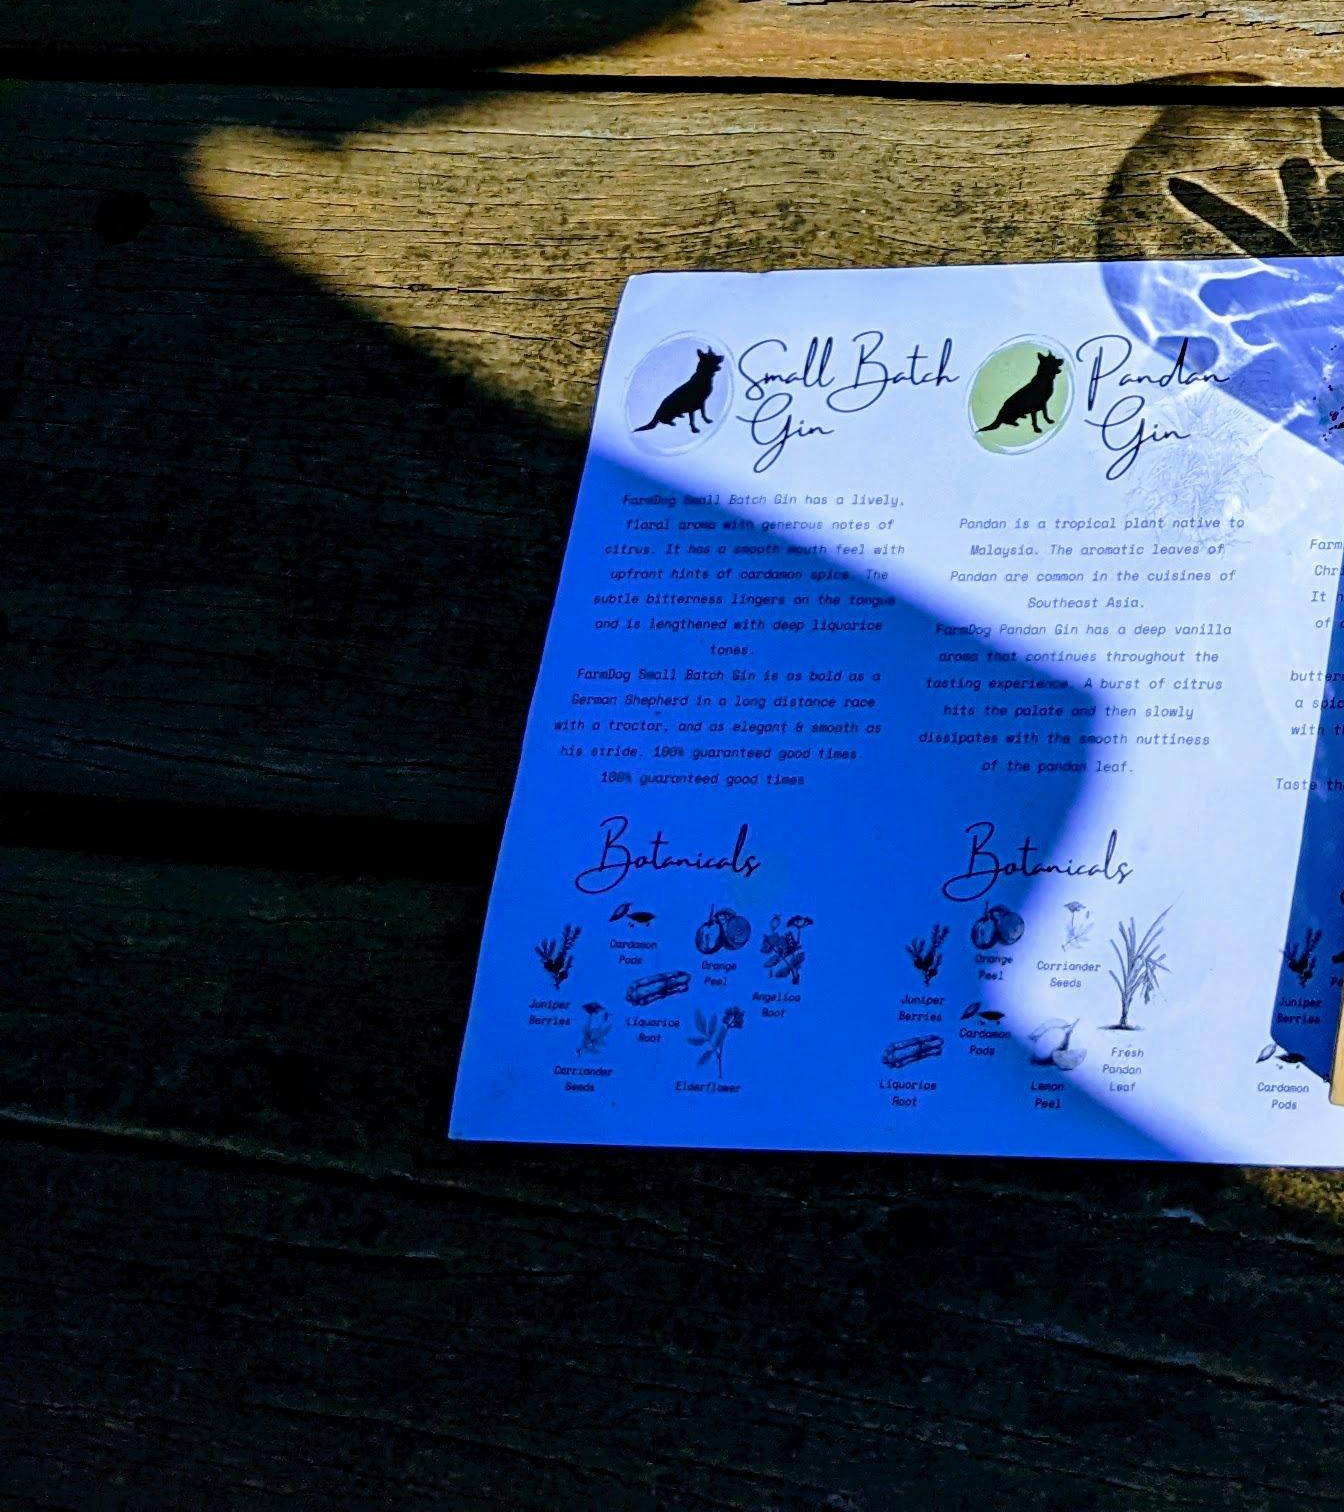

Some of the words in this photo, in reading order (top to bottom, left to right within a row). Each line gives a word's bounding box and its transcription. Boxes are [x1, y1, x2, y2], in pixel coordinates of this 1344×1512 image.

[737, 336, 836, 402] Small
[826, 330, 961, 414] Batch
[1075, 334, 1231, 411] Pandan
[735, 392, 835, 474] Gin
[1083, 394, 1192, 481] Gin
[622, 494, 677, 509] FarmDog
[683, 494, 721, 507] Small
[728, 493, 767, 507] Batch
[773, 492, 798, 506] Gin
[804, 493, 828, 506] has
[835, 496, 845, 506] a
[851, 493, 905, 509] lively,
[625, 518, 671, 532] floral
[761, 520, 824, 534] generous
[831, 518, 871, 532] notes
[877, 518, 896, 531] of
[959, 517, 1007, 530] Pandan
[1014, 516, 1031, 530] is
[1037, 520, 1047, 530] a
[1053, 516, 1117, 534] tropical
[1123, 516, 1165, 533] plant
[1171, 516, 1221, 530] native
[1228, 517, 1245, 530] to
[970, 543, 1041, 560] Malaysia.
[1049, 543, 1074, 556] The
[1080, 543, 1145, 556] aromatic
[1151, 542, 1200, 556] leaves
[1206, 542, 1225, 556] of
[949, 569, 998, 583] Pandan
[1004, 572, 1030, 583] are
[1035, 571, 1086, 583] common
[1091, 569, 1109, 582] in
[1115, 569, 1141, 582] the
[1146, 569, 1212, 582] cuisines
[1218, 568, 1237, 582] of
[1027, 596, 1099, 610] Southeast
[1105, 596, 1146, 610] Asia.
[935, 623, 993, 639] FarmDog
[999, 623, 1048, 636] Pandan
[1053, 623, 1079, 636] Gin
[1085, 623, 1110, 636] has
[1116, 625, 1127, 636] a
[1133, 623, 1167, 639] deep
[1173, 623, 1233, 636] vanilla
[574, 815, 761, 894] Botanicals
[941, 821, 1134, 902] Botanicals
[1036, 960, 1102, 973] Corriander
[1049, 977, 1082, 989] Seeds
[1110, 1047, 1145, 1058] Fresh
[1102, 1063, 1143, 1075] Pandan
[1270, 1099, 1298, 1111] Pods
